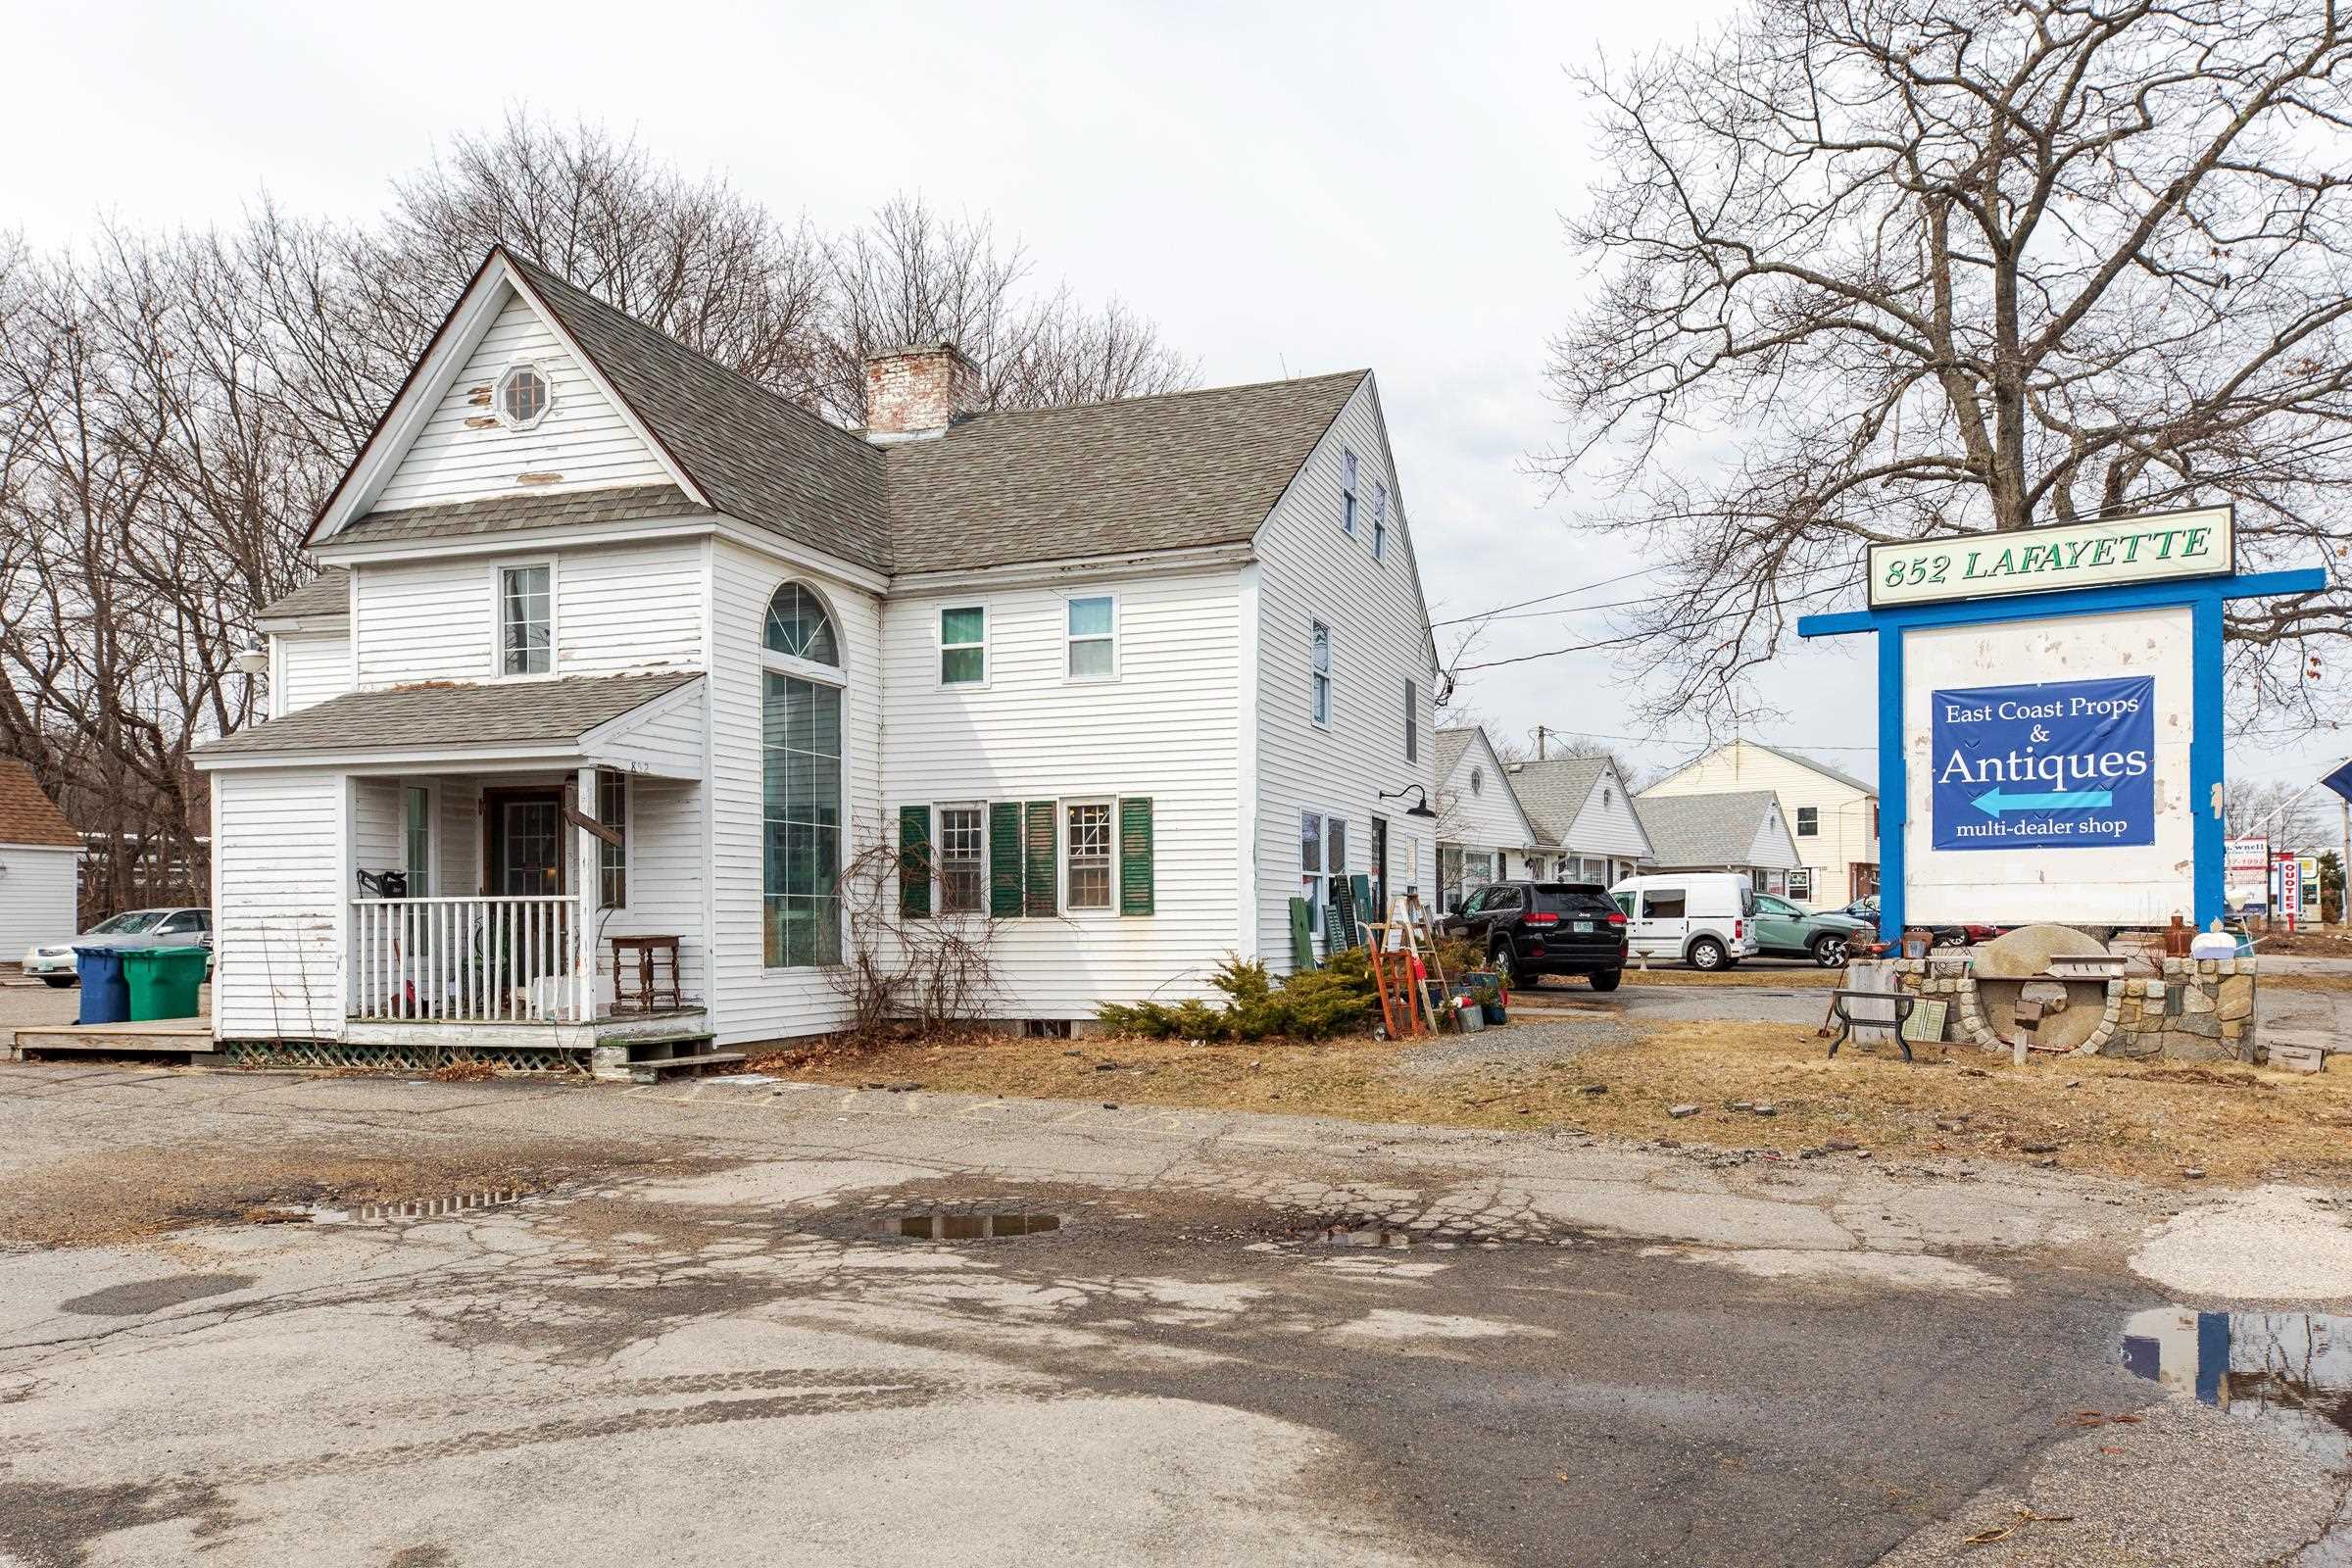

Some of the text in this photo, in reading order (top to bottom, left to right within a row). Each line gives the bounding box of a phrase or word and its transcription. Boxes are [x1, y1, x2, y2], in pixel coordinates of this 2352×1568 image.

[1885, 527, 2212, 588] 852 LAFAYETTE
[1945, 697, 2139, 723] East Coast Props
[2030, 724, 2050, 743] &
[1938, 746, 2147, 792] Antiques
[1956, 817, 2128, 838] multi-dealer shop
[2284, 864, 2295, 909] QUOTES
